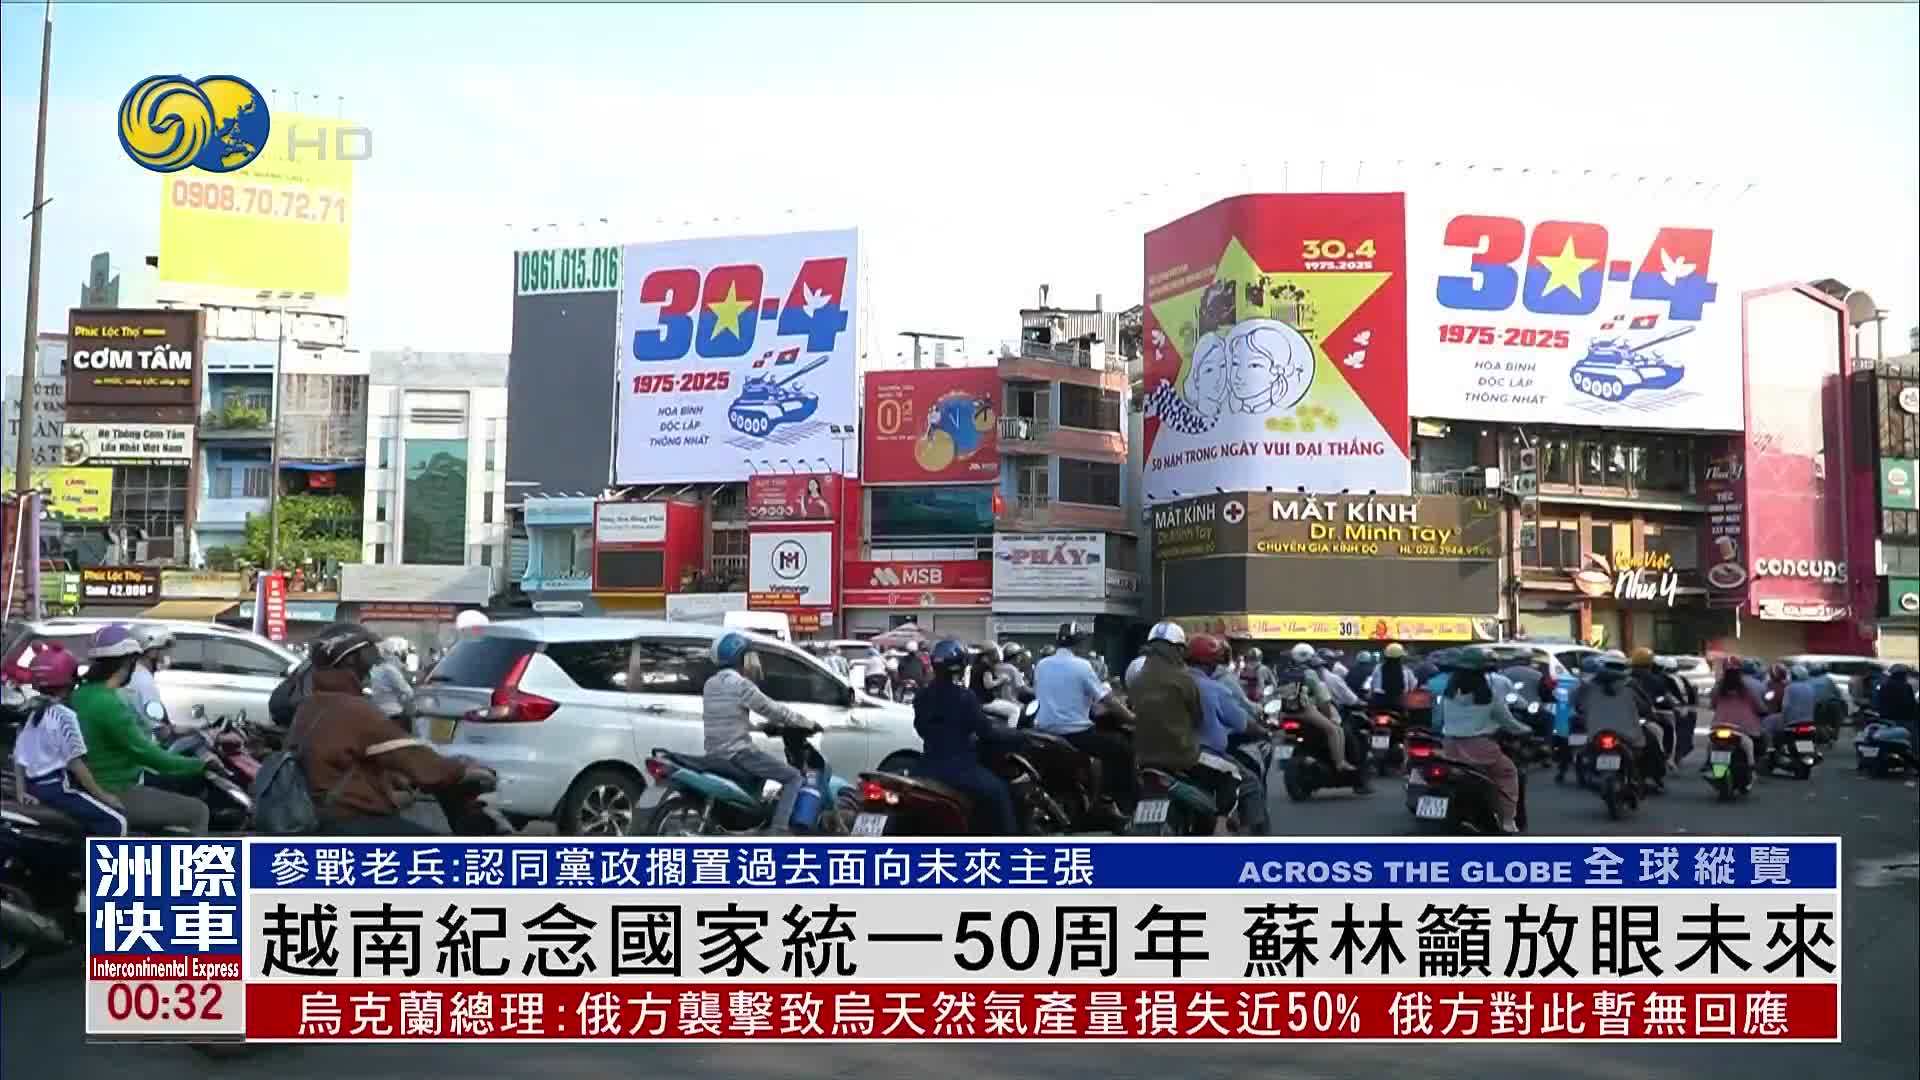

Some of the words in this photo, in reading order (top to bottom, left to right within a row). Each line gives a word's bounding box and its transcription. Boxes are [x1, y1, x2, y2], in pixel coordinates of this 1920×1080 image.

[171, 179, 346, 224] 0908.70.72.71
[1302, 239, 1377, 259] 30.4
[521, 247, 619, 292] 0961.015.016
[73, 347, 133, 369] CƠM
[138, 344, 192, 369] TẤM
[1263, 442, 1290, 455] VUI
[1348, 497, 1417, 523] KÍNH
[1345, 523, 1401, 542] Minh
[1308, 542, 1329, 553] GIA
[903, 569, 943, 584] MSB
